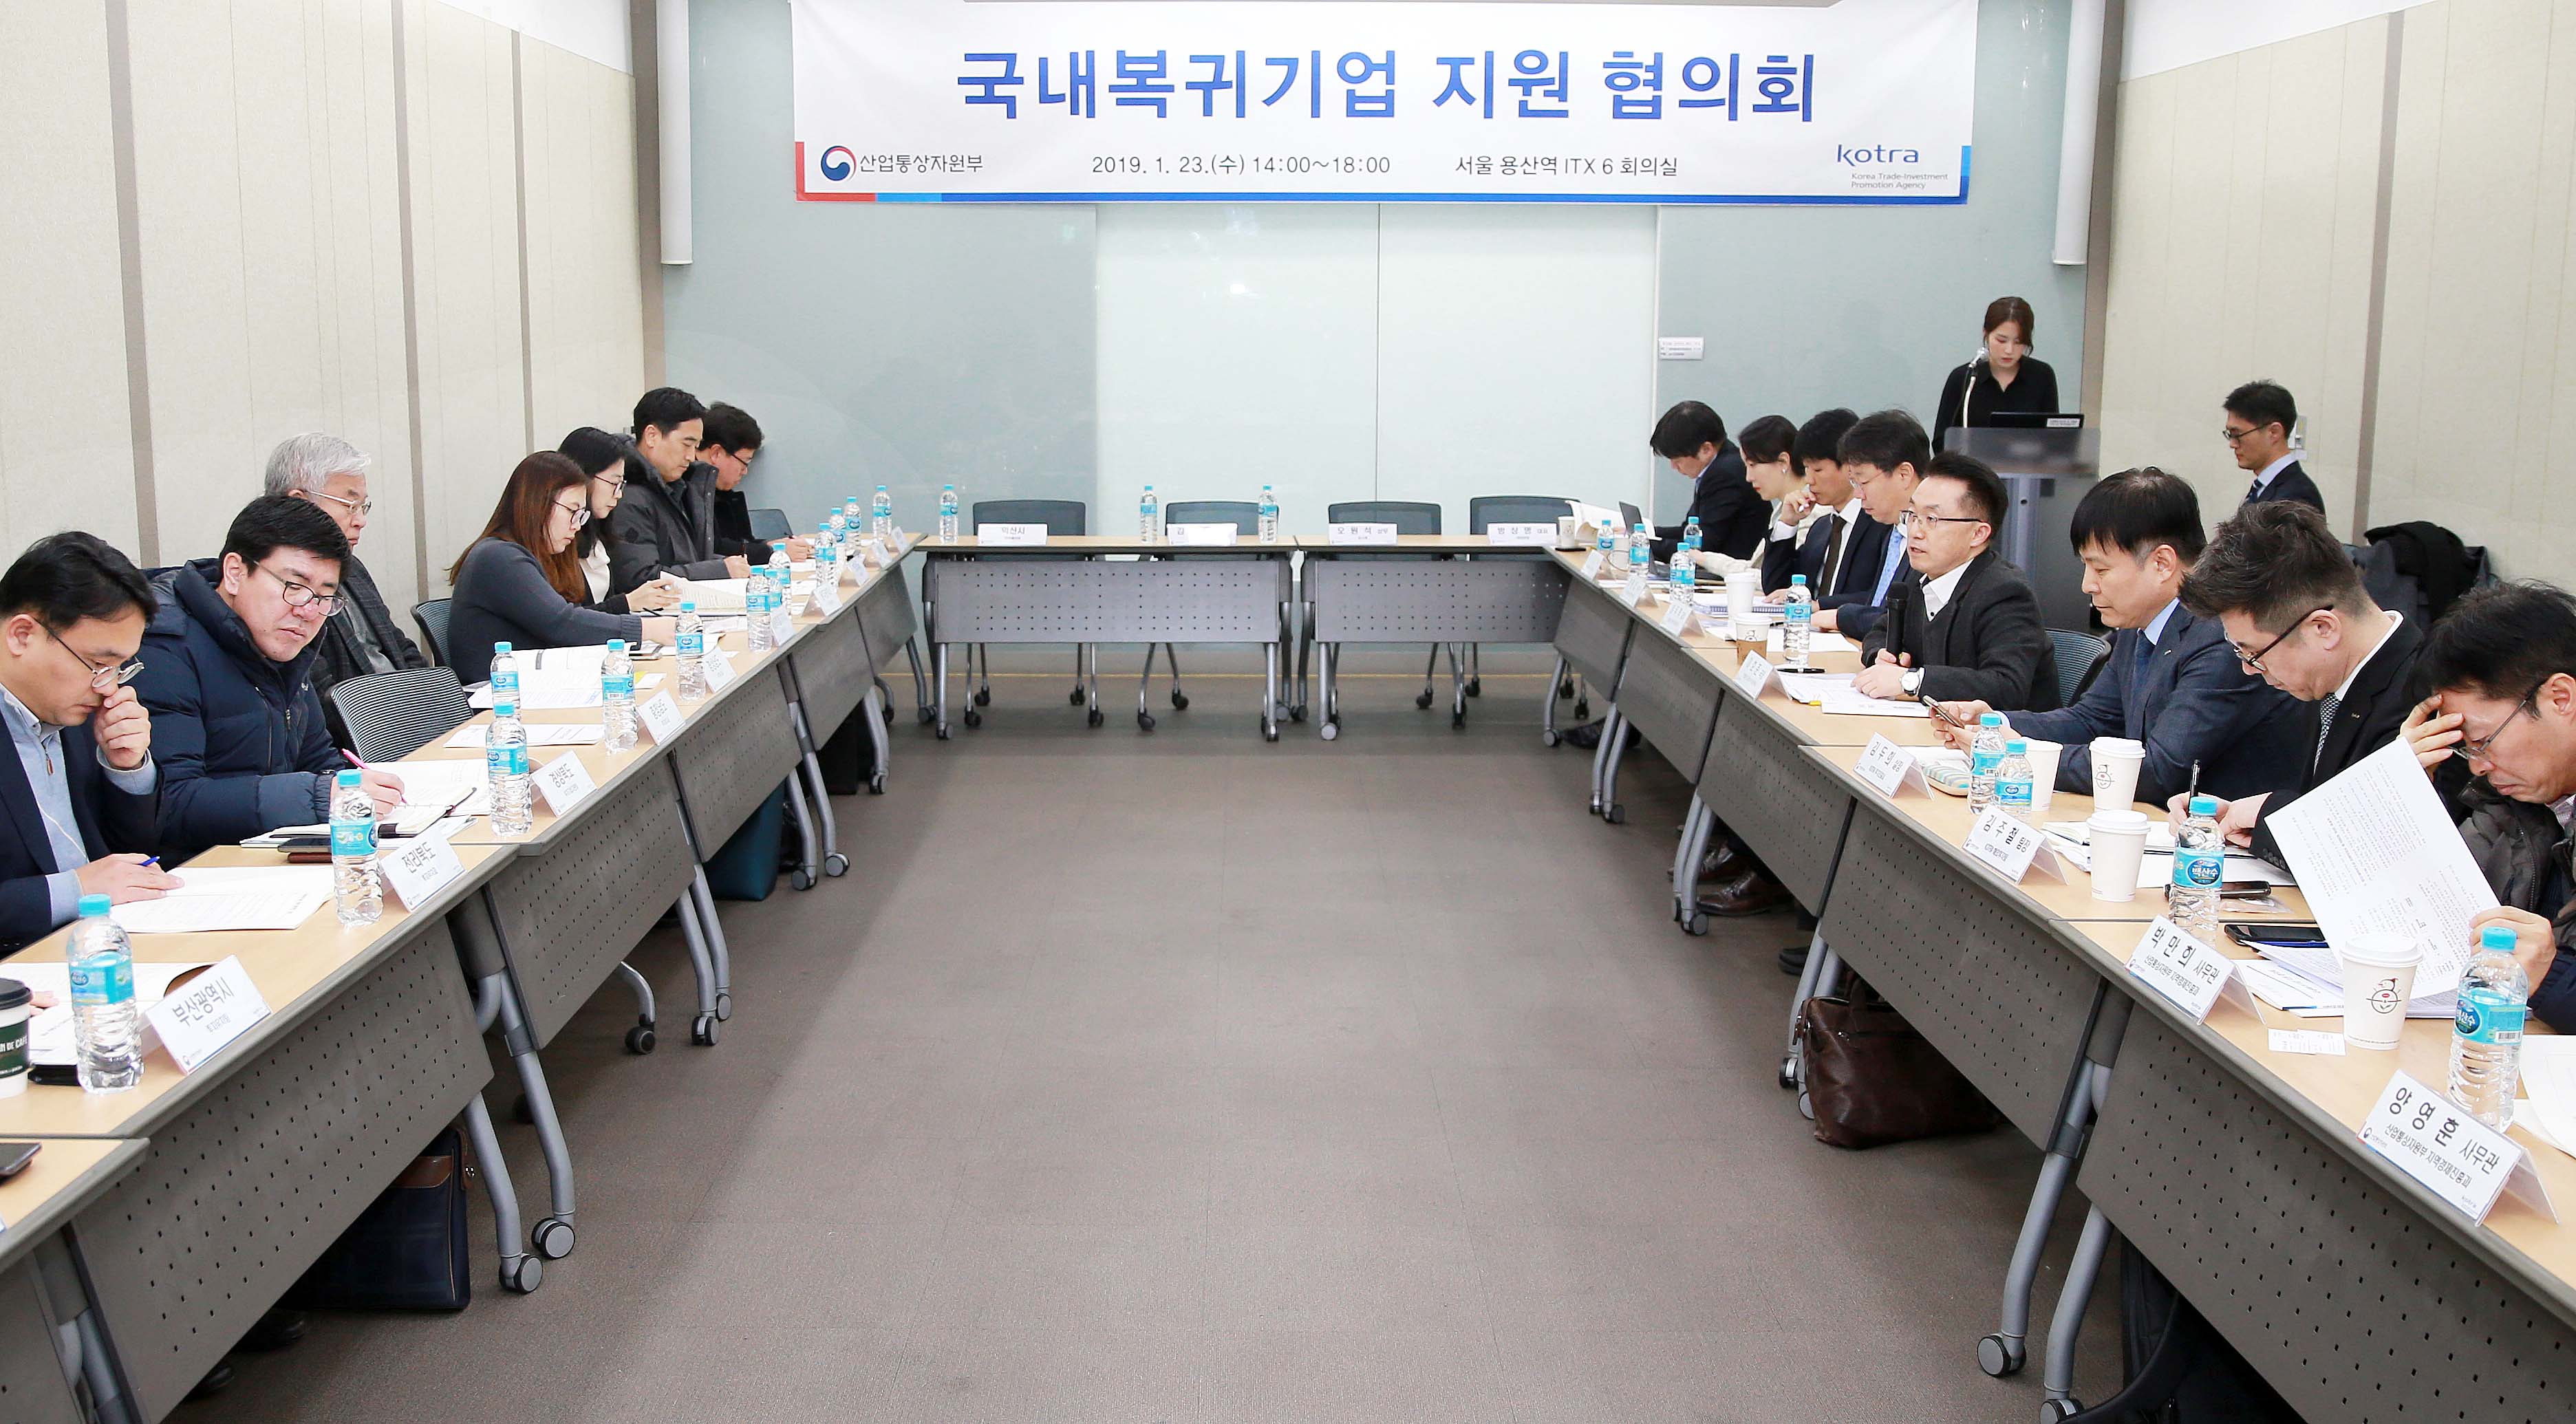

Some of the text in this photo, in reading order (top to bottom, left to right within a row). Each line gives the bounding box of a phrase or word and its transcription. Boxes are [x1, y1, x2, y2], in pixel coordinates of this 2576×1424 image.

[957, 49, 1814, 122] 국내복귀기업 지원 협의회
[859, 153, 984, 174] 산업통상자원부
[1093, 156, 1147, 174] 2019.
[1156, 157, 1170, 174] 1.
[1455, 155, 1677, 176] 서울 용산역 ITX 6 회의실
[1836, 144, 1919, 167] kotra
[1896, 182, 1926, 190] Agency
[2191, 867, 2219, 878] 백산수
[2193, 960, 2220, 986] 사무관
[171, 975, 235, 1028] 부산광역시
[2384, 1123, 2429, 1158] 산업통상자원부
[2425, 1150, 2473, 1189] 지역경제진흥과
[2458, 1139, 2500, 1175] 사무관
